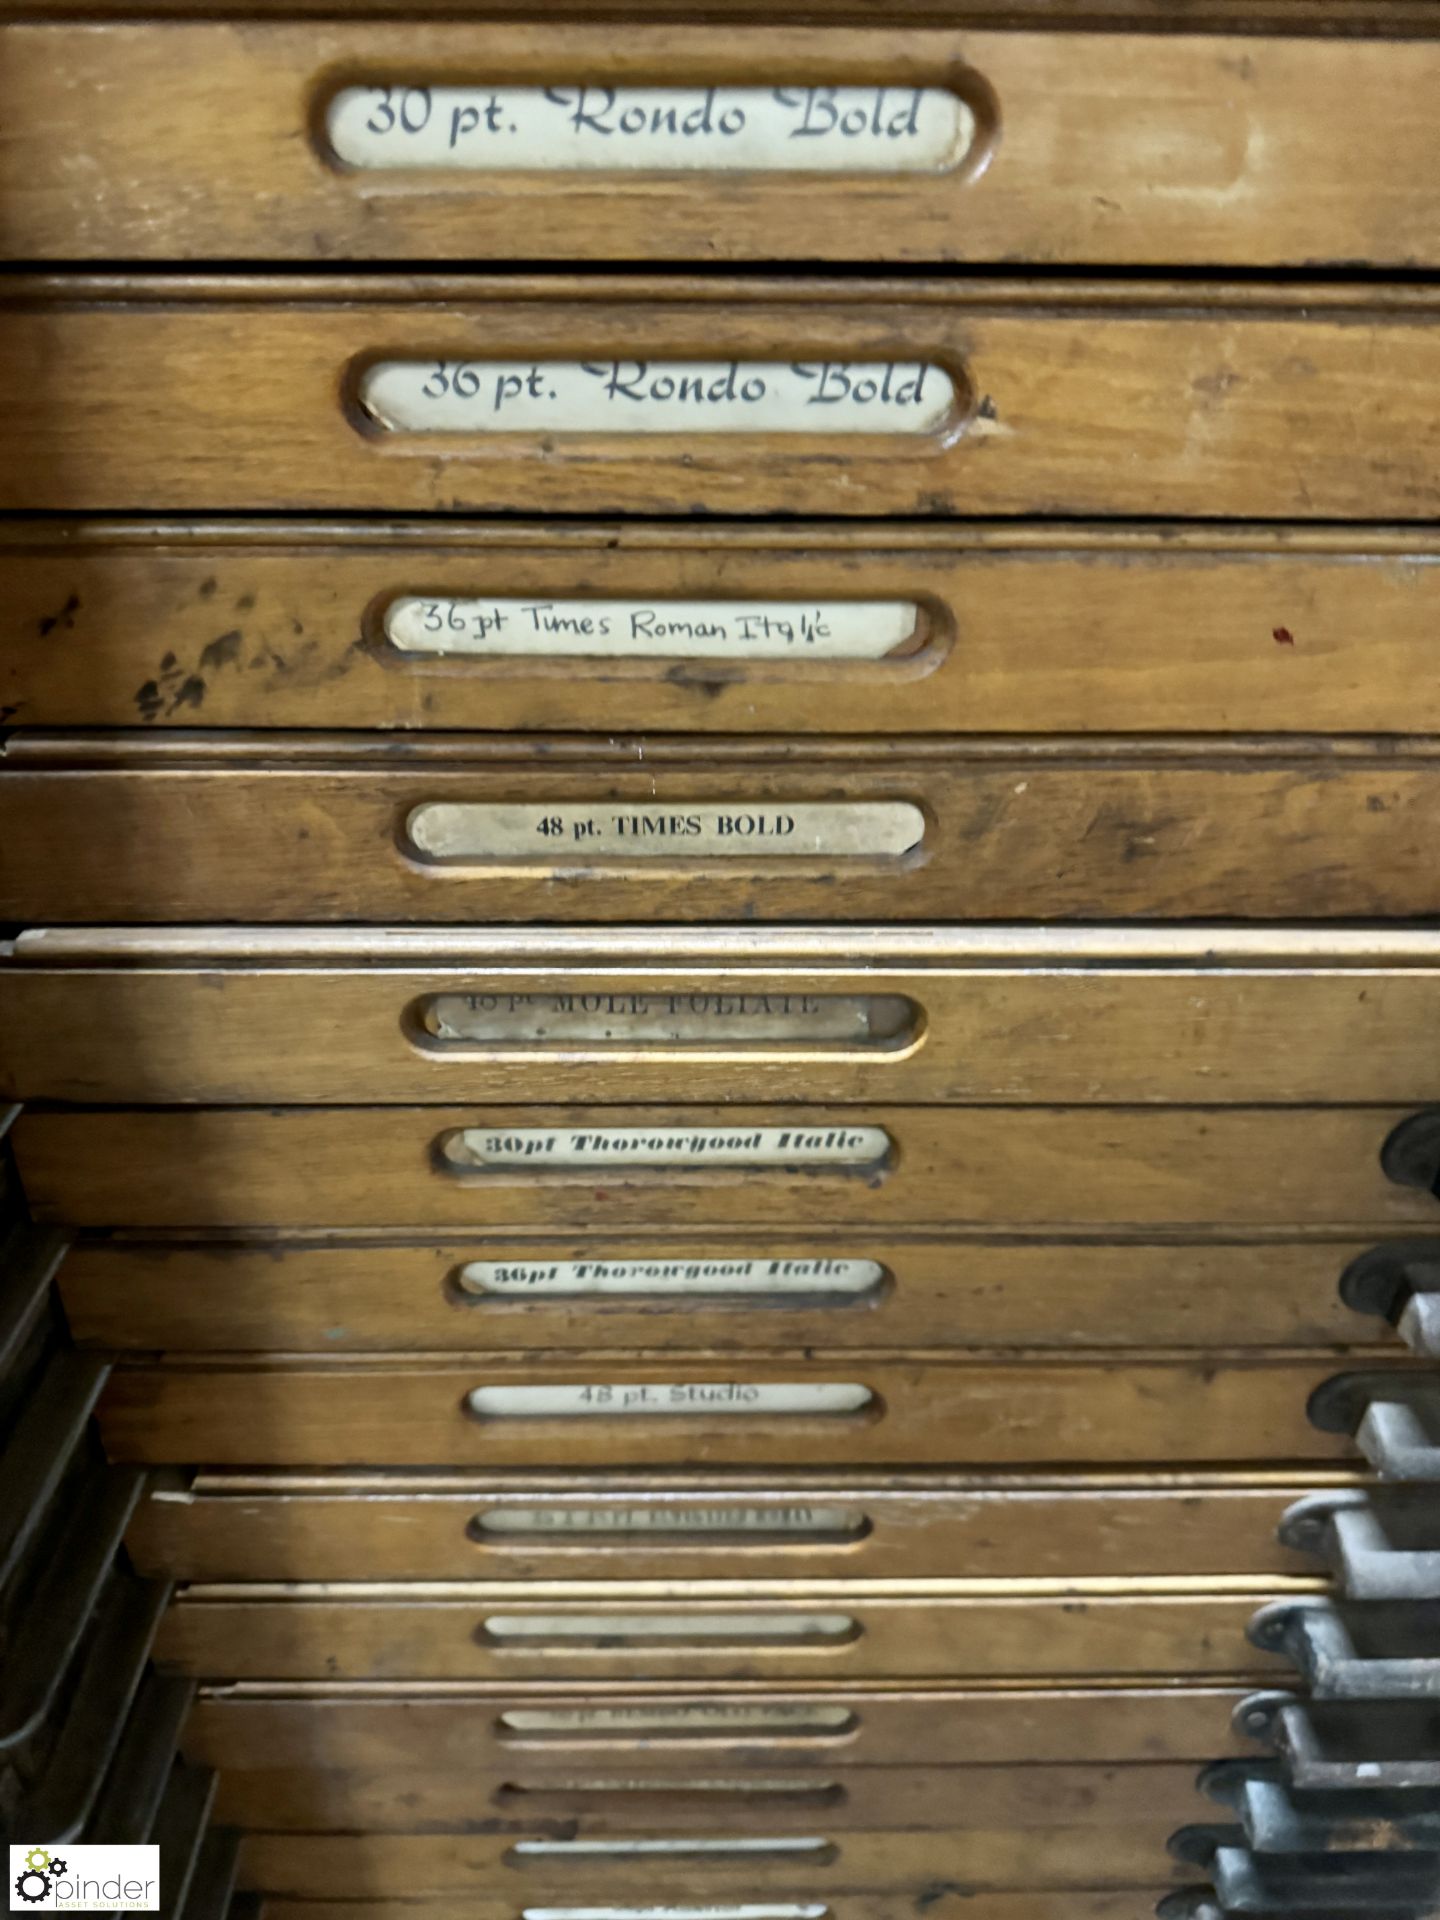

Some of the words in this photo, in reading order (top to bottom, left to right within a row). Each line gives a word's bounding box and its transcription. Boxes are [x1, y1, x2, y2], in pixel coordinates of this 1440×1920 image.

[449, 95, 518, 148] pt.
[544, 86, 746, 137] Rondo
[772, 86, 921, 138] Bold
[494, 366, 557, 411] pt.
[580, 361, 767, 402] Rondo
[790, 361, 927, 405] Bold
[521, 604, 611, 636] Times
[630, 610, 727, 640] Roman
[536, 816, 564, 837] 48
[574, 816, 602, 840] pt.
[611, 814, 702, 836] TIMES
[716, 813, 796, 835] BOLD
[776, 1130, 864, 1150] Italic
[669, 1384, 760, 1403] Studio
